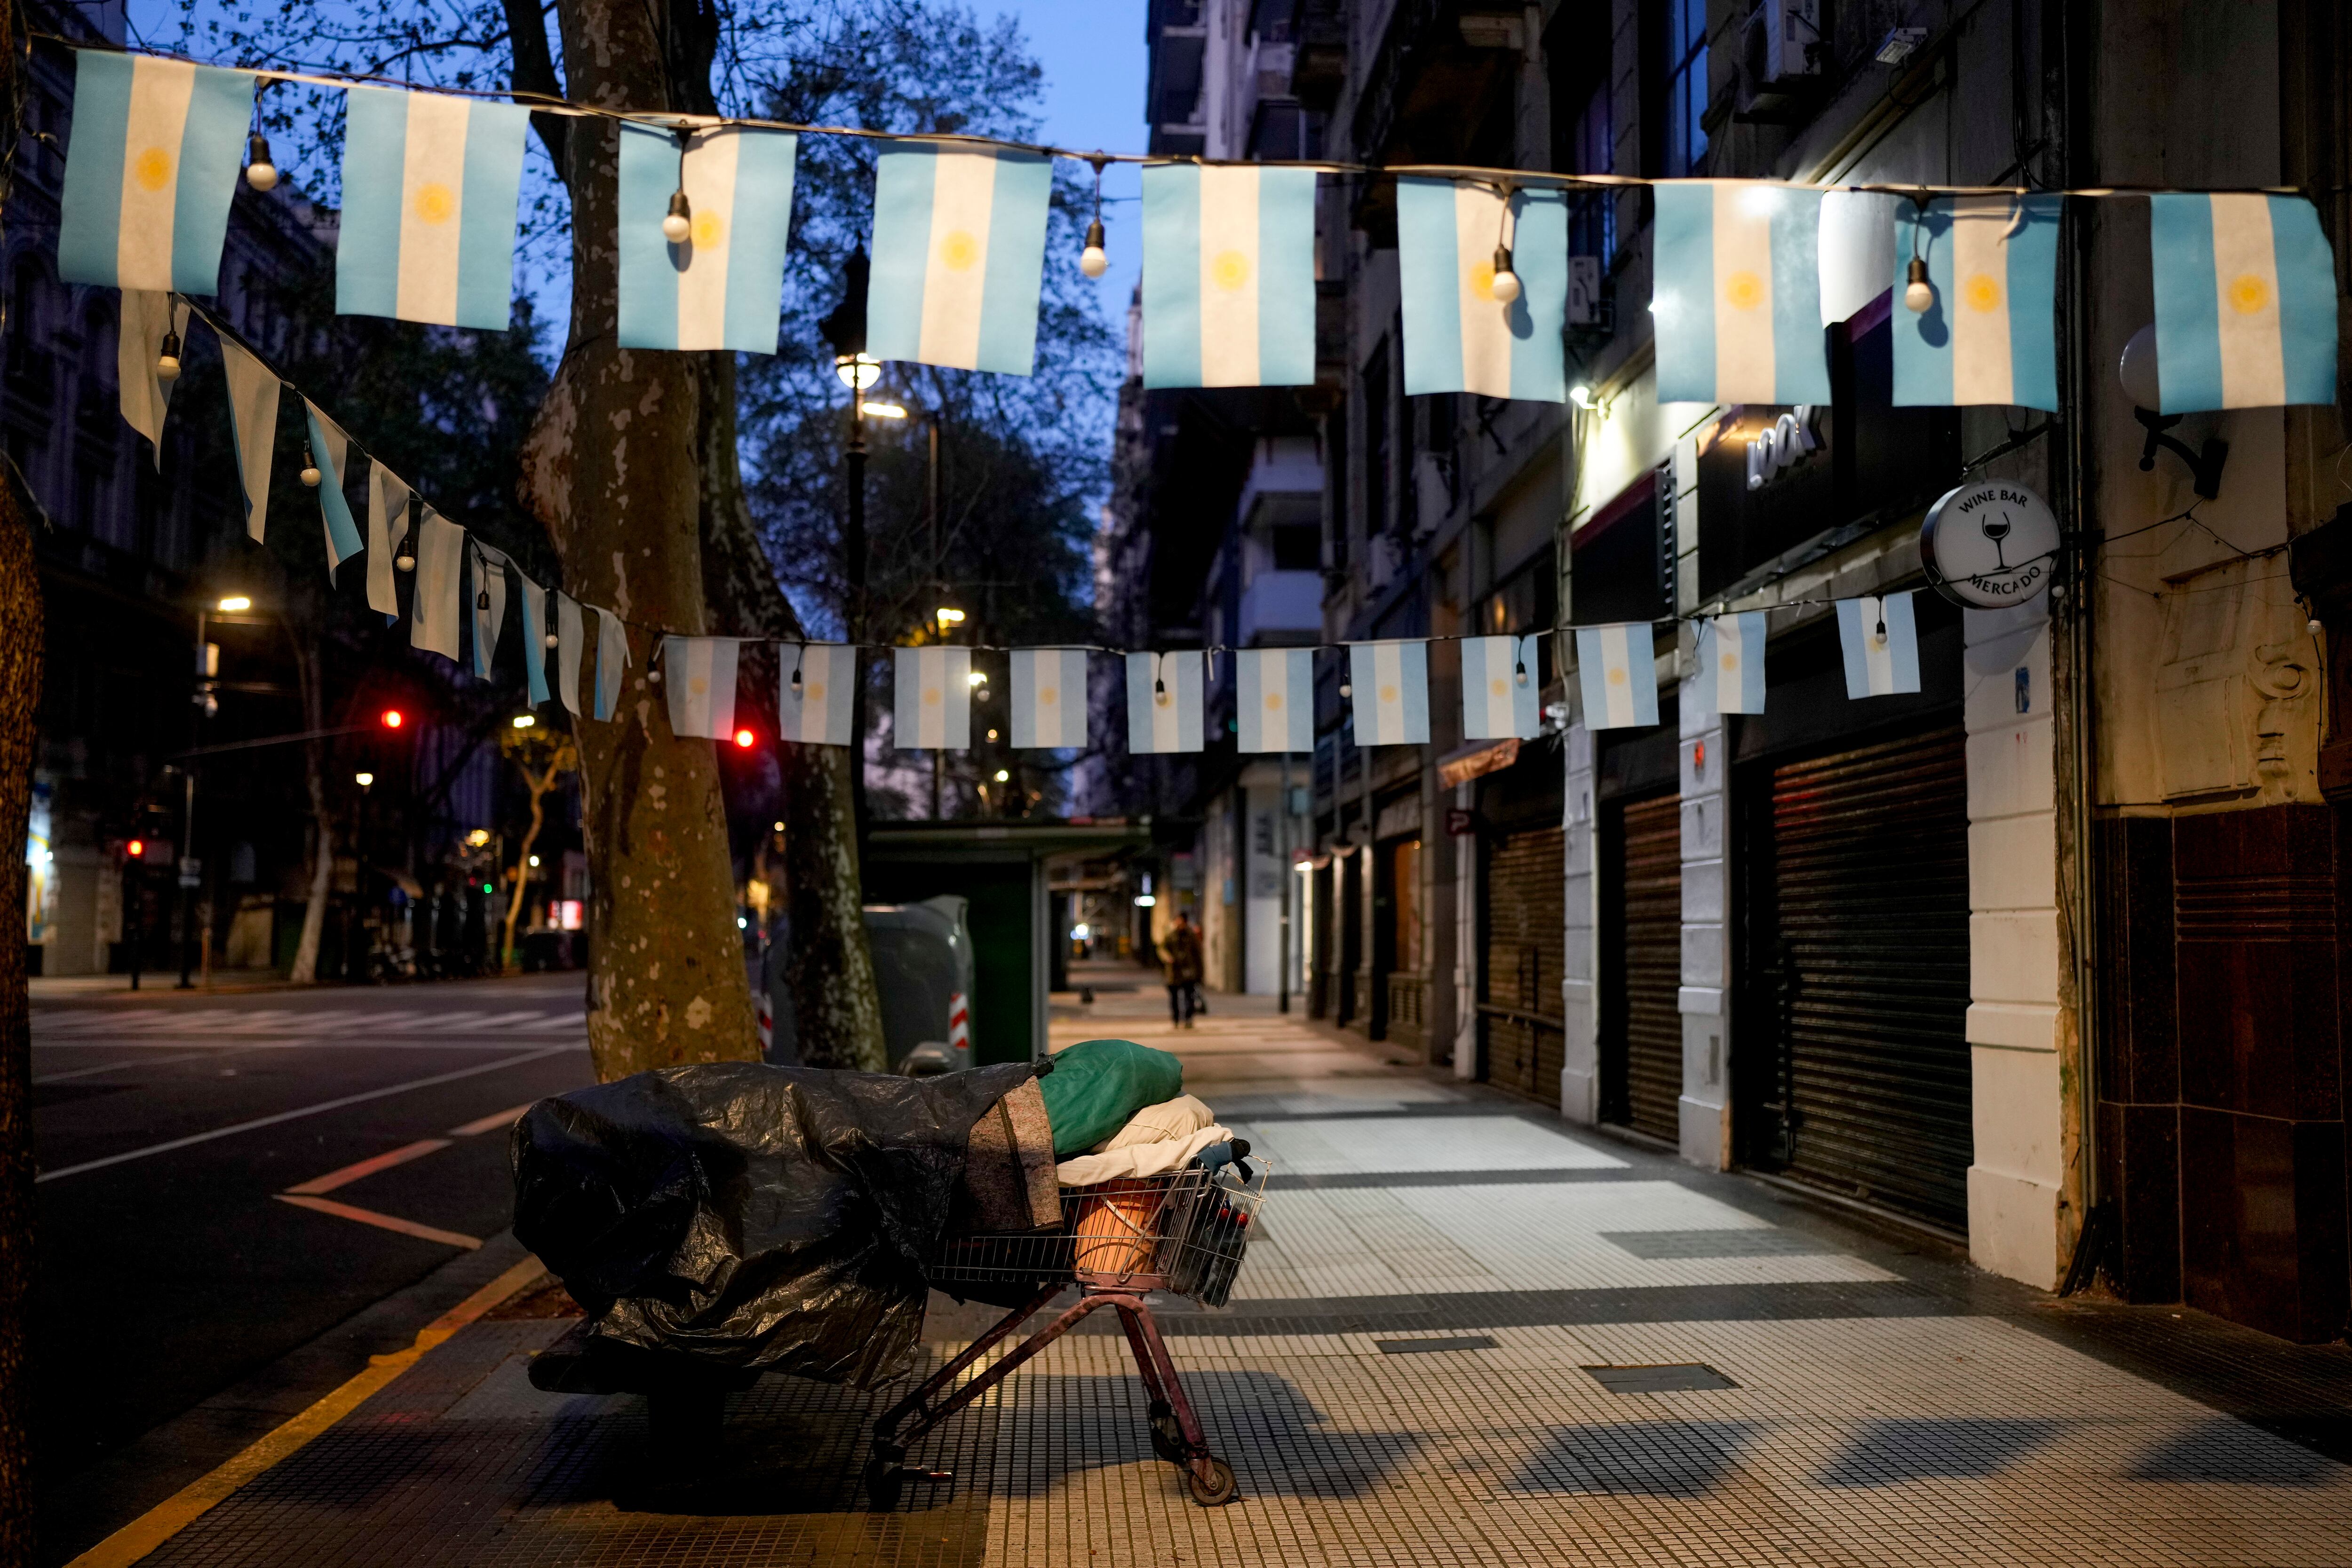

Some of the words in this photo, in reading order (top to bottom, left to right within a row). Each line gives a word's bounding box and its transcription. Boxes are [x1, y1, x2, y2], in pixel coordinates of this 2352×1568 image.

[1959, 490, 1995, 513] WINE
[2000, 490, 2027, 507] BAR
[1968, 567, 2041, 595] MERCADO
